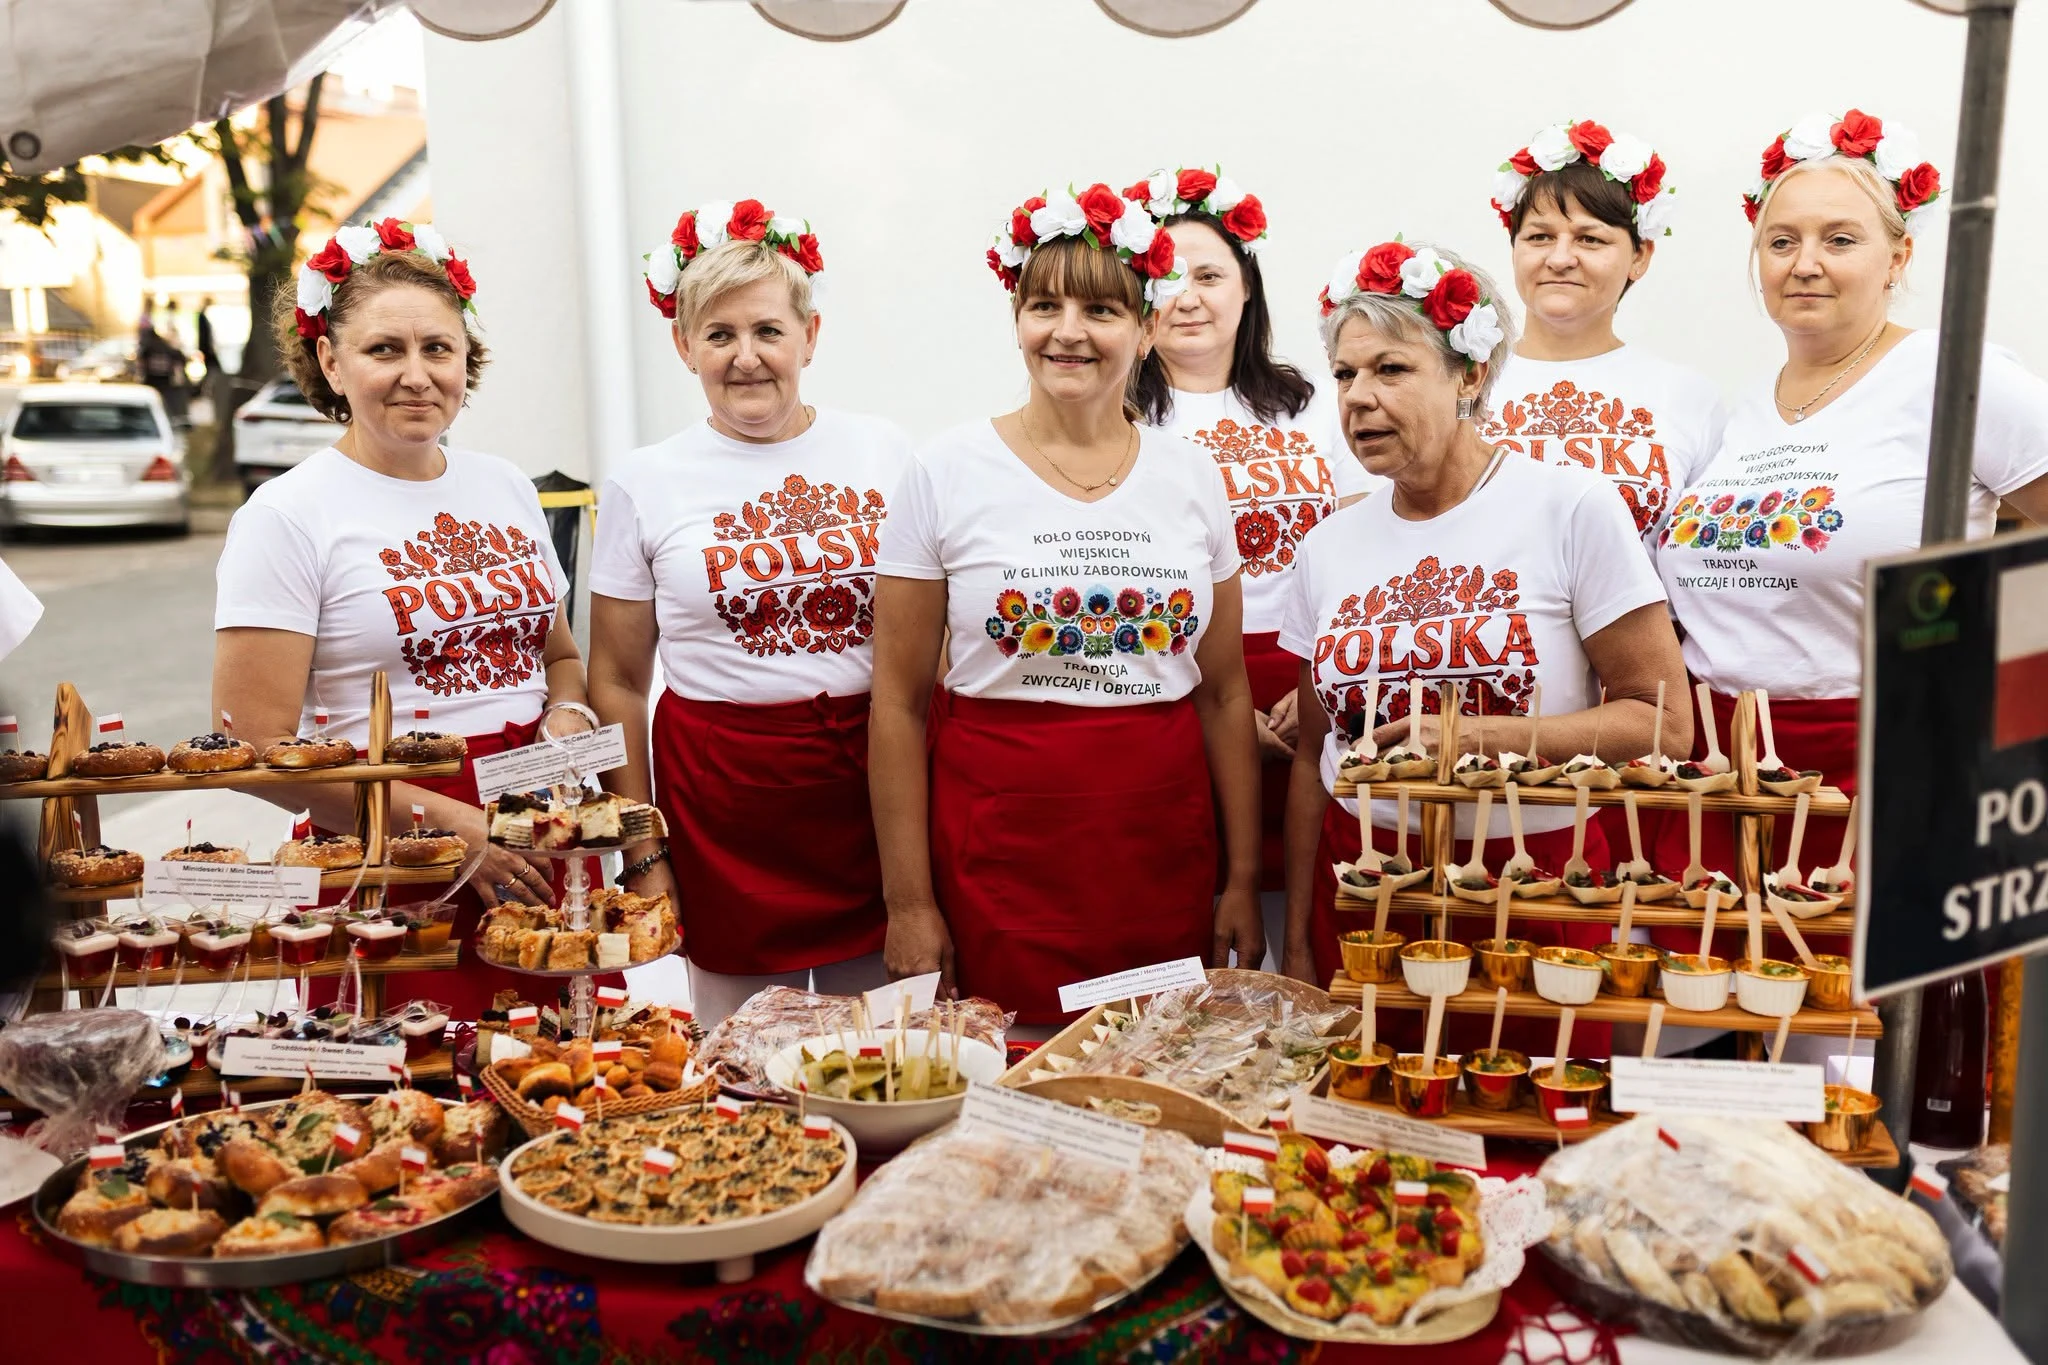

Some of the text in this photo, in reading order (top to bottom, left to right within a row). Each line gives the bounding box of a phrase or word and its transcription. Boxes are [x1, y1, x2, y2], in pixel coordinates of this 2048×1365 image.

[1766, 442, 1829, 457] GOSPODYŃ
[1492, 437, 1672, 489] LSKA
[1745, 458, 1797, 474] WIEJSKICH
[1220, 457, 1336, 501] LSKA
[1706, 479, 1751, 488] GLINIKU
[1751, 472, 1839, 487] ZABOROWSKIM
[1033, 529, 1152, 545] KOŁO GOSPODYŃ
[701, 523, 880, 593] POLSK
[1059, 548, 1130, 560] WIEJSKICH
[1003, 565, 1188, 580] W GLINIKU ZABOROWSKIM
[1703, 559, 1758, 572] TRADYCJA
[1676, 577, 1799, 591] ZWYCZAJE I OBYCZAJE
[382, 560, 557, 636] POLSK
[1315, 613, 1540, 685] POLSKA
[1063, 662, 1128, 678] TRADYCJA
[1021, 675, 1162, 697] ZWYCZAJE I OBYCZAJE
[571, 733, 591, 743] Cakes
[592, 728, 613, 738] atter
[182, 865, 224, 874] Minideserki
[230, 867, 246, 875] Mini
